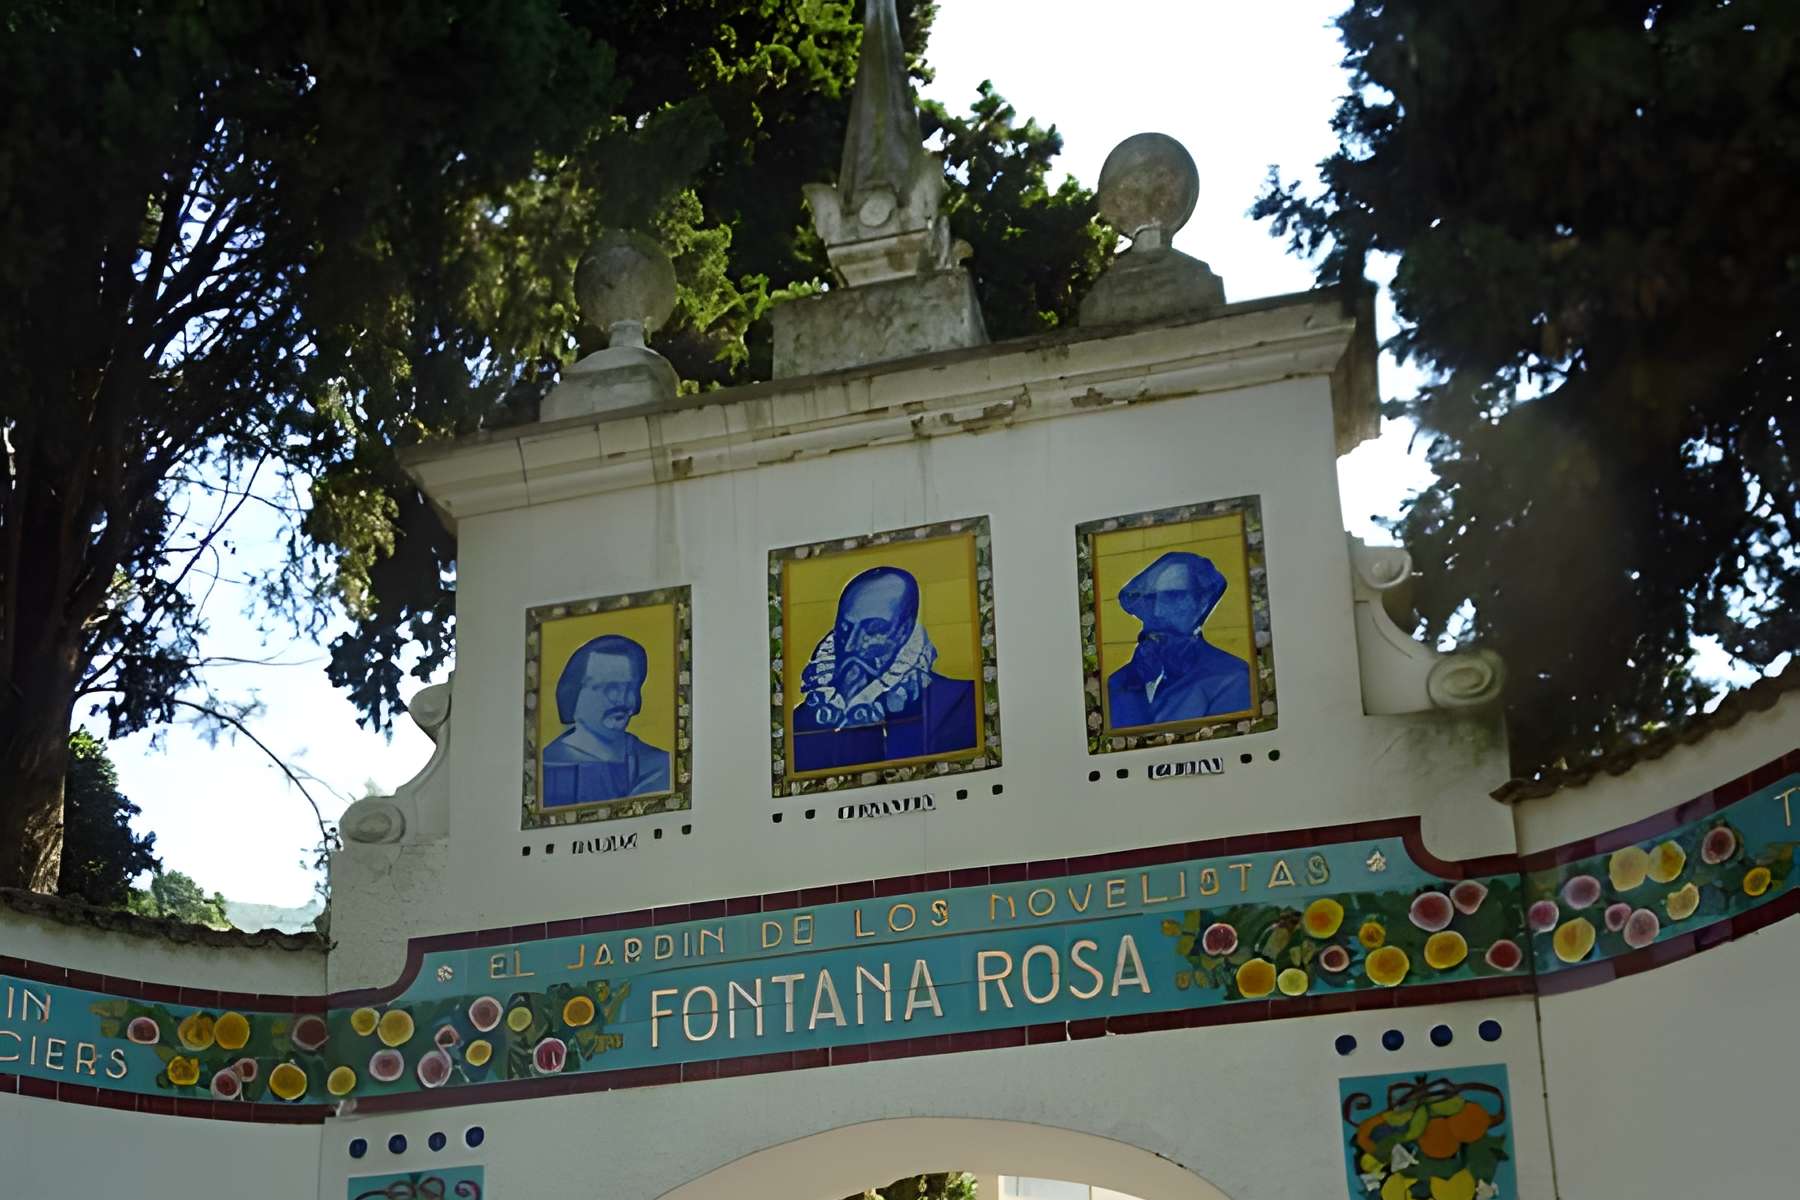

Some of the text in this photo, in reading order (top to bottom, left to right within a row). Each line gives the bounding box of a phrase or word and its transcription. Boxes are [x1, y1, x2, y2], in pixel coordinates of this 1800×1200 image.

[490, 851, 1330, 979] EL JARDIN DE LOS NOVELISTAS
[650, 934, 1151, 1049] FONTANA ROSA
